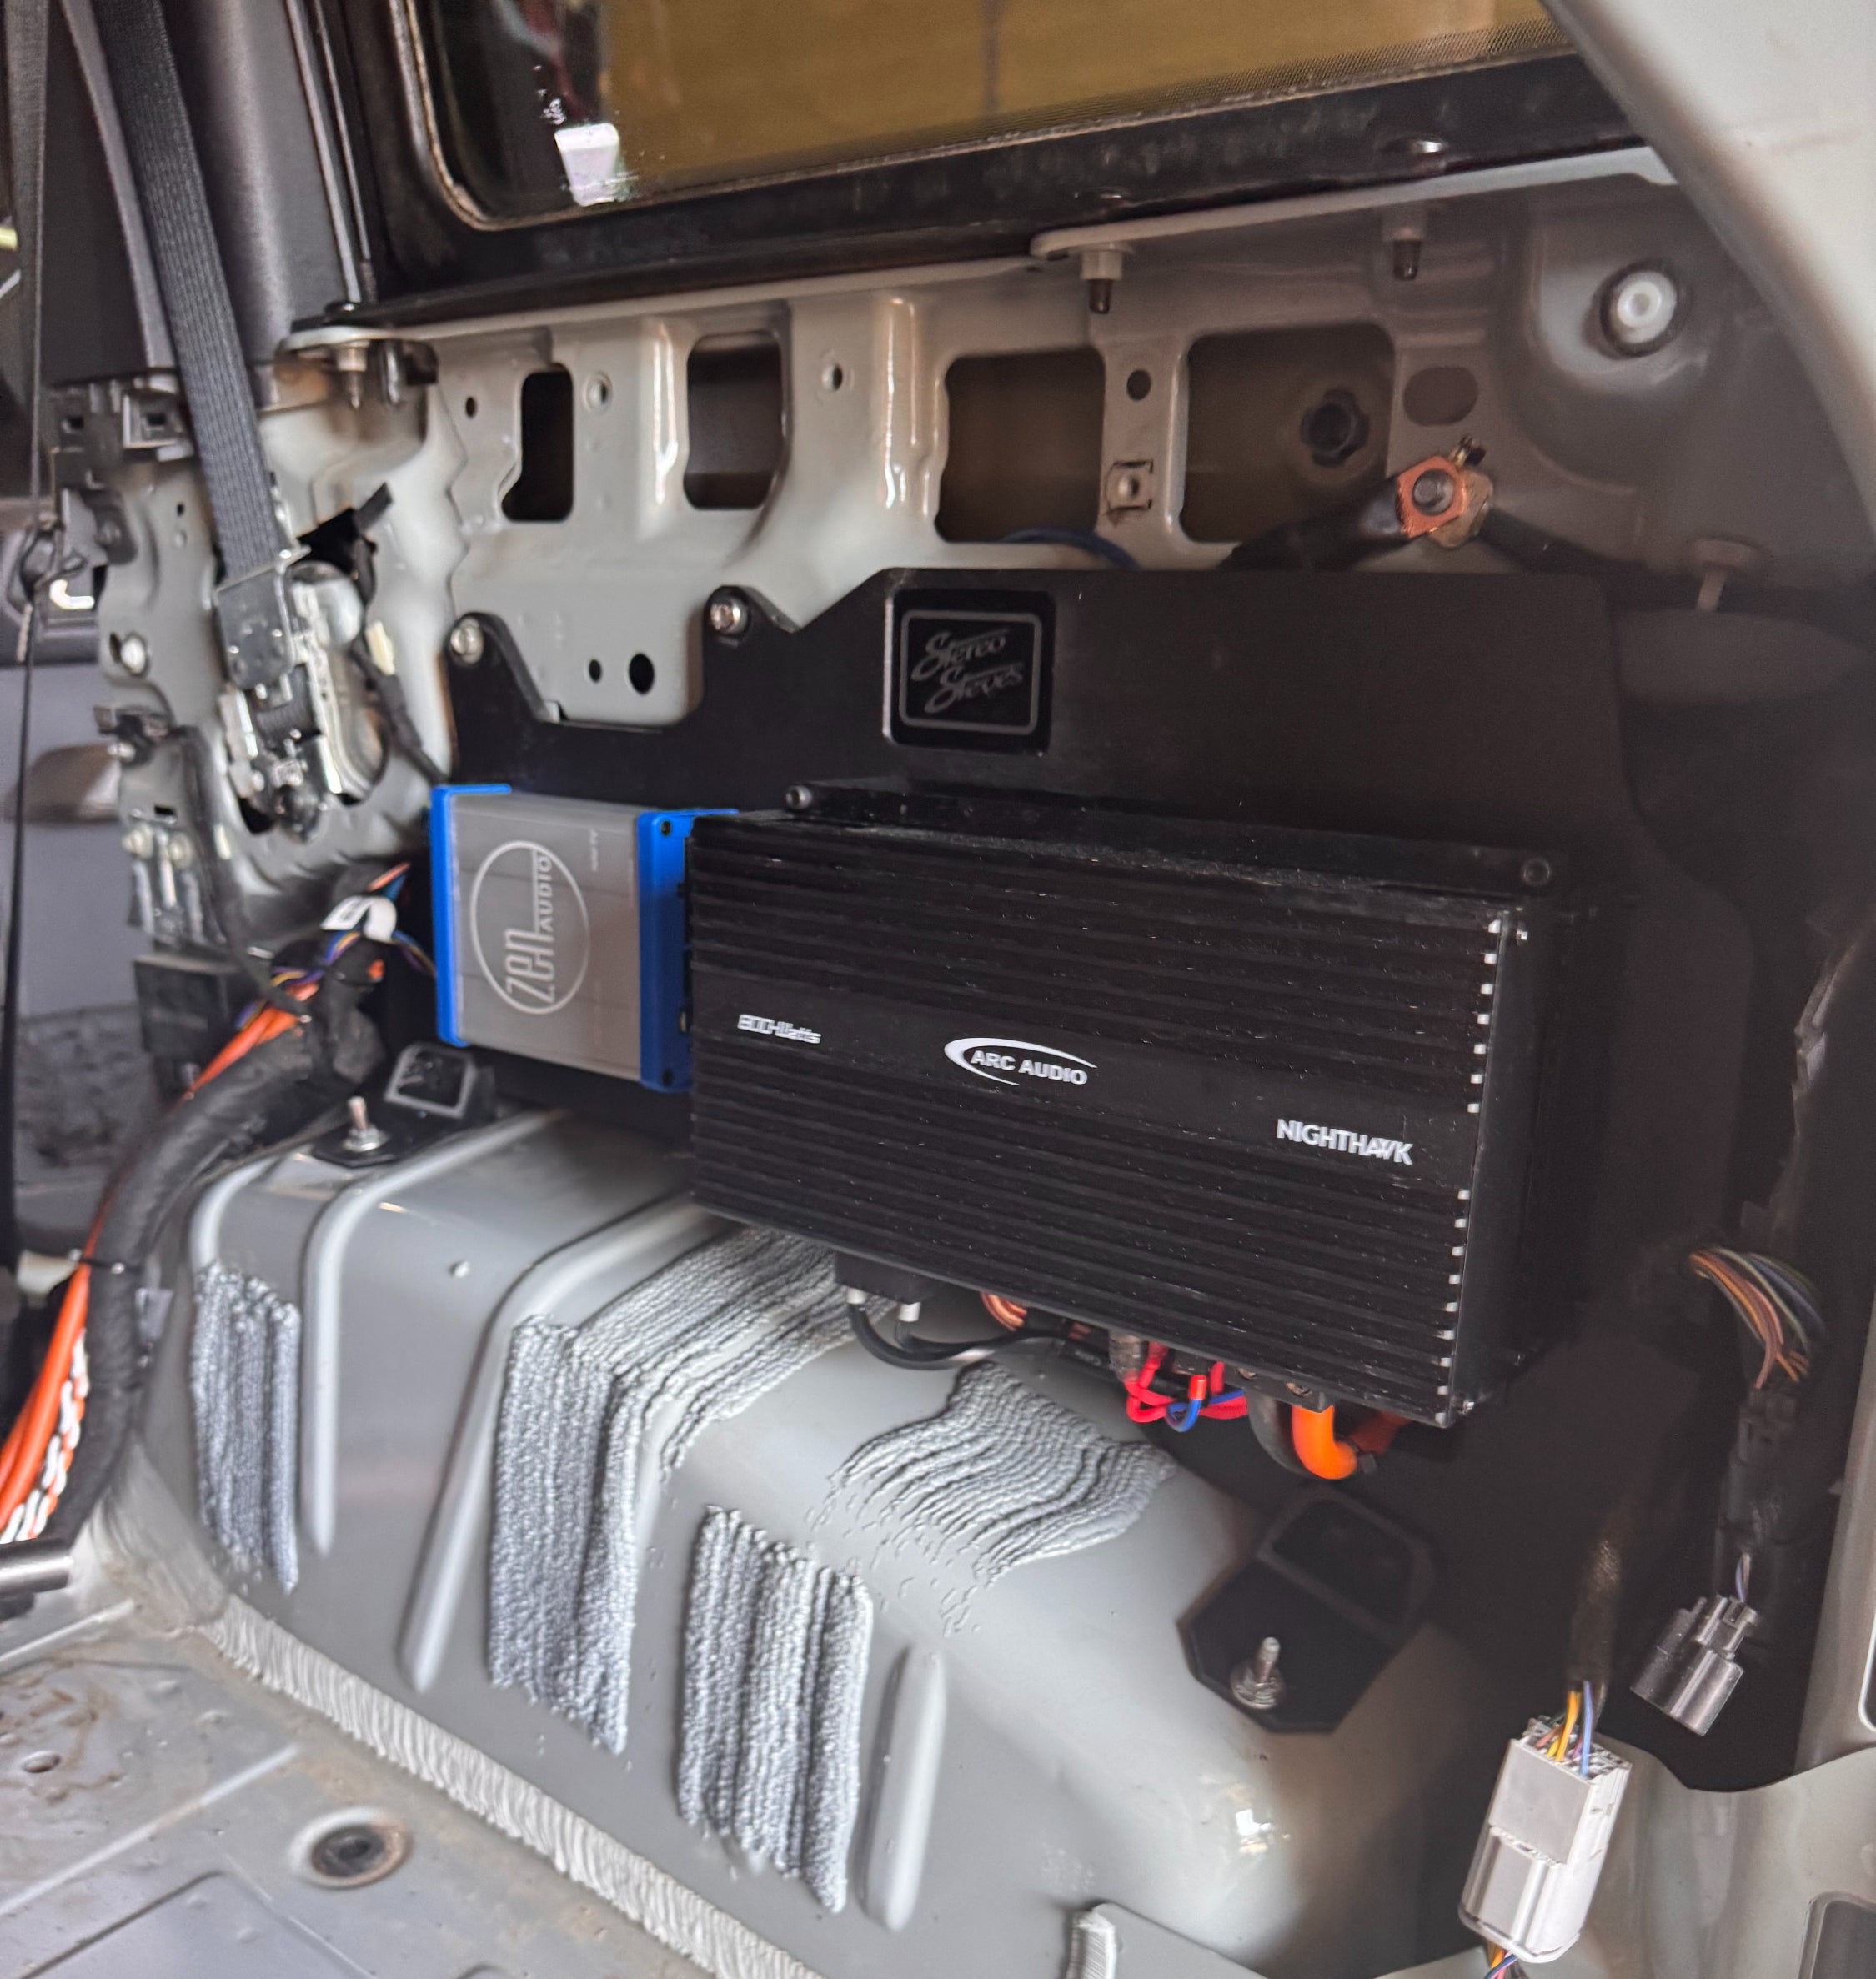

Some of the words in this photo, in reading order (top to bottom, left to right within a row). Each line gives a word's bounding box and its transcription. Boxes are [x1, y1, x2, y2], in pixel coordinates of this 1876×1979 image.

[538, 855, 554, 934] AUDIO
[971, 1050, 1016, 1071] ARC
[1018, 1060, 1088, 1085] AUDIO
[1276, 1118, 1414, 1165] NIGHTHAWK
